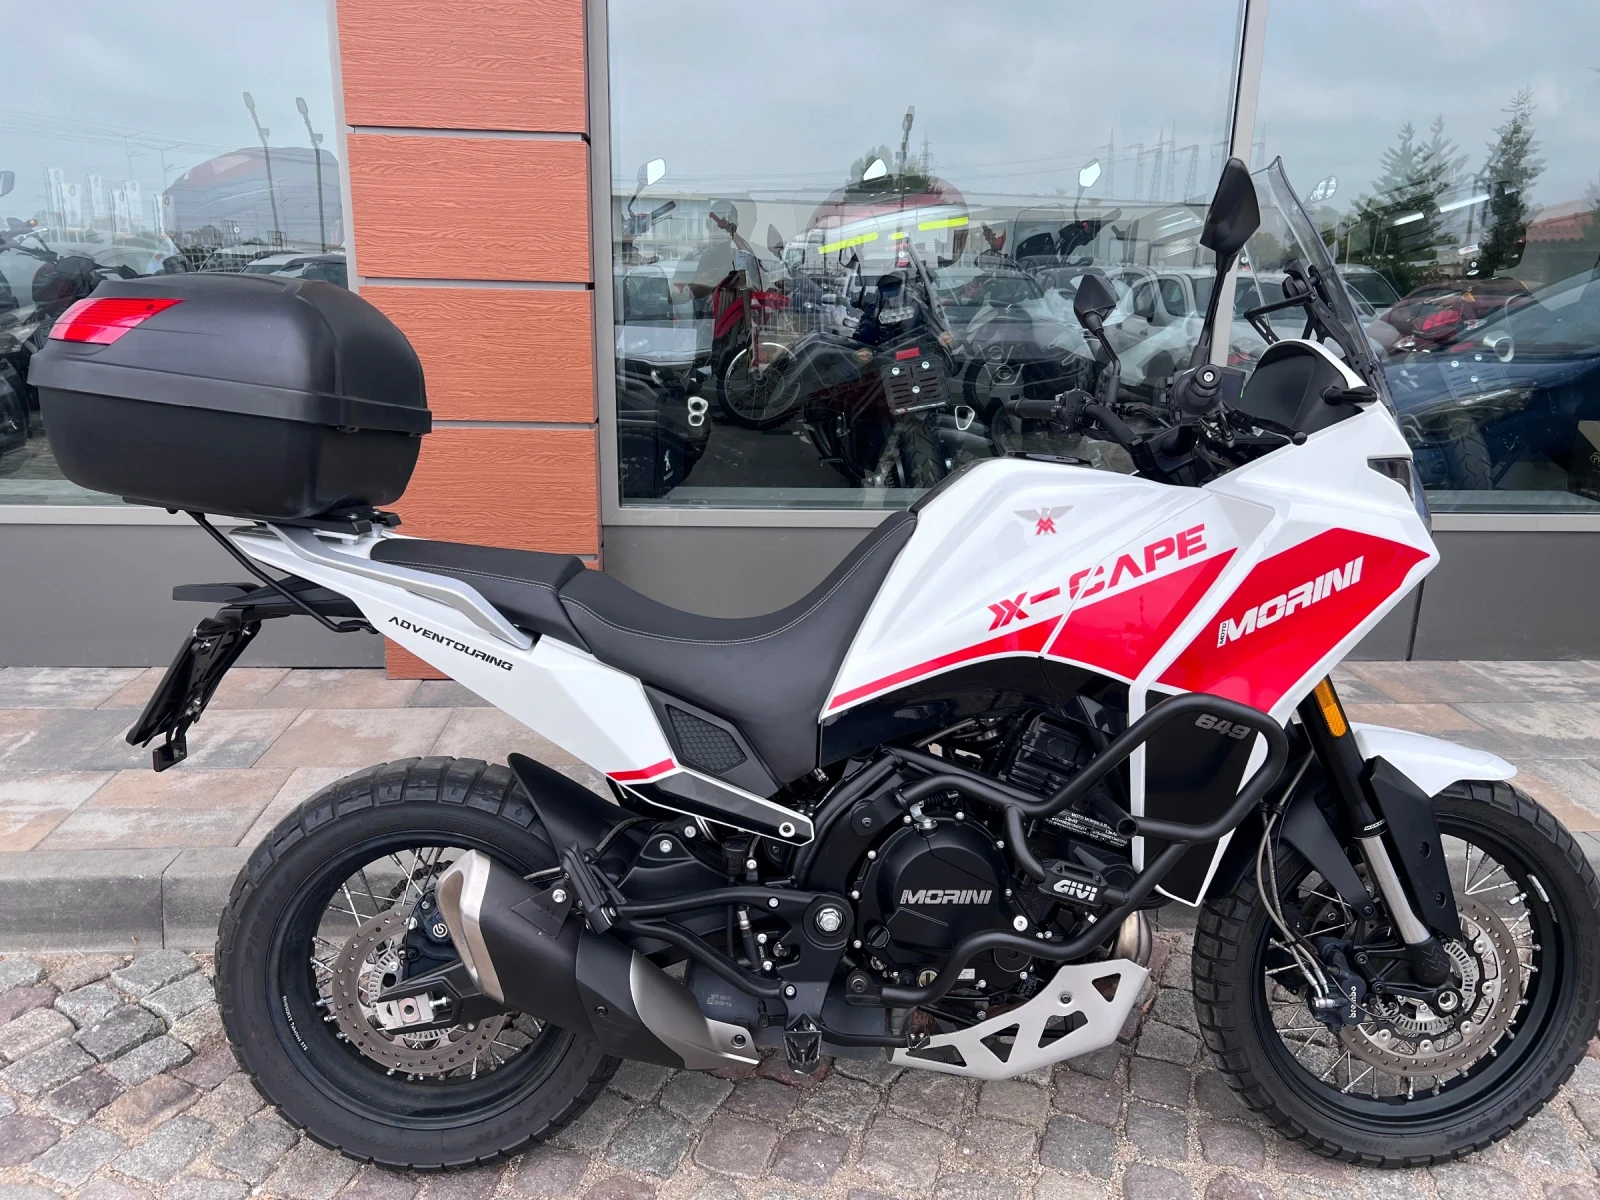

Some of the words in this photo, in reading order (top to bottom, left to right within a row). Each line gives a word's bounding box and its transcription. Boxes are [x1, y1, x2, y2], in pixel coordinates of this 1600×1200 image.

[1219, 622, 1227, 645] MOTO
[1226, 555, 1364, 642] MORINI
[388, 616, 513, 671] ADVENTOURING
[1195, 713, 1251, 740] 649
[907, 889, 992, 905] MORINI
[1053, 879, 1098, 902] GIVI
[1348, 985, 1357, 1019] brembo
[1556, 934, 1593, 1062] SCORPION
[1496, 1059, 1558, 1122] RALLY
[1444, 1117, 1493, 1145] STR
